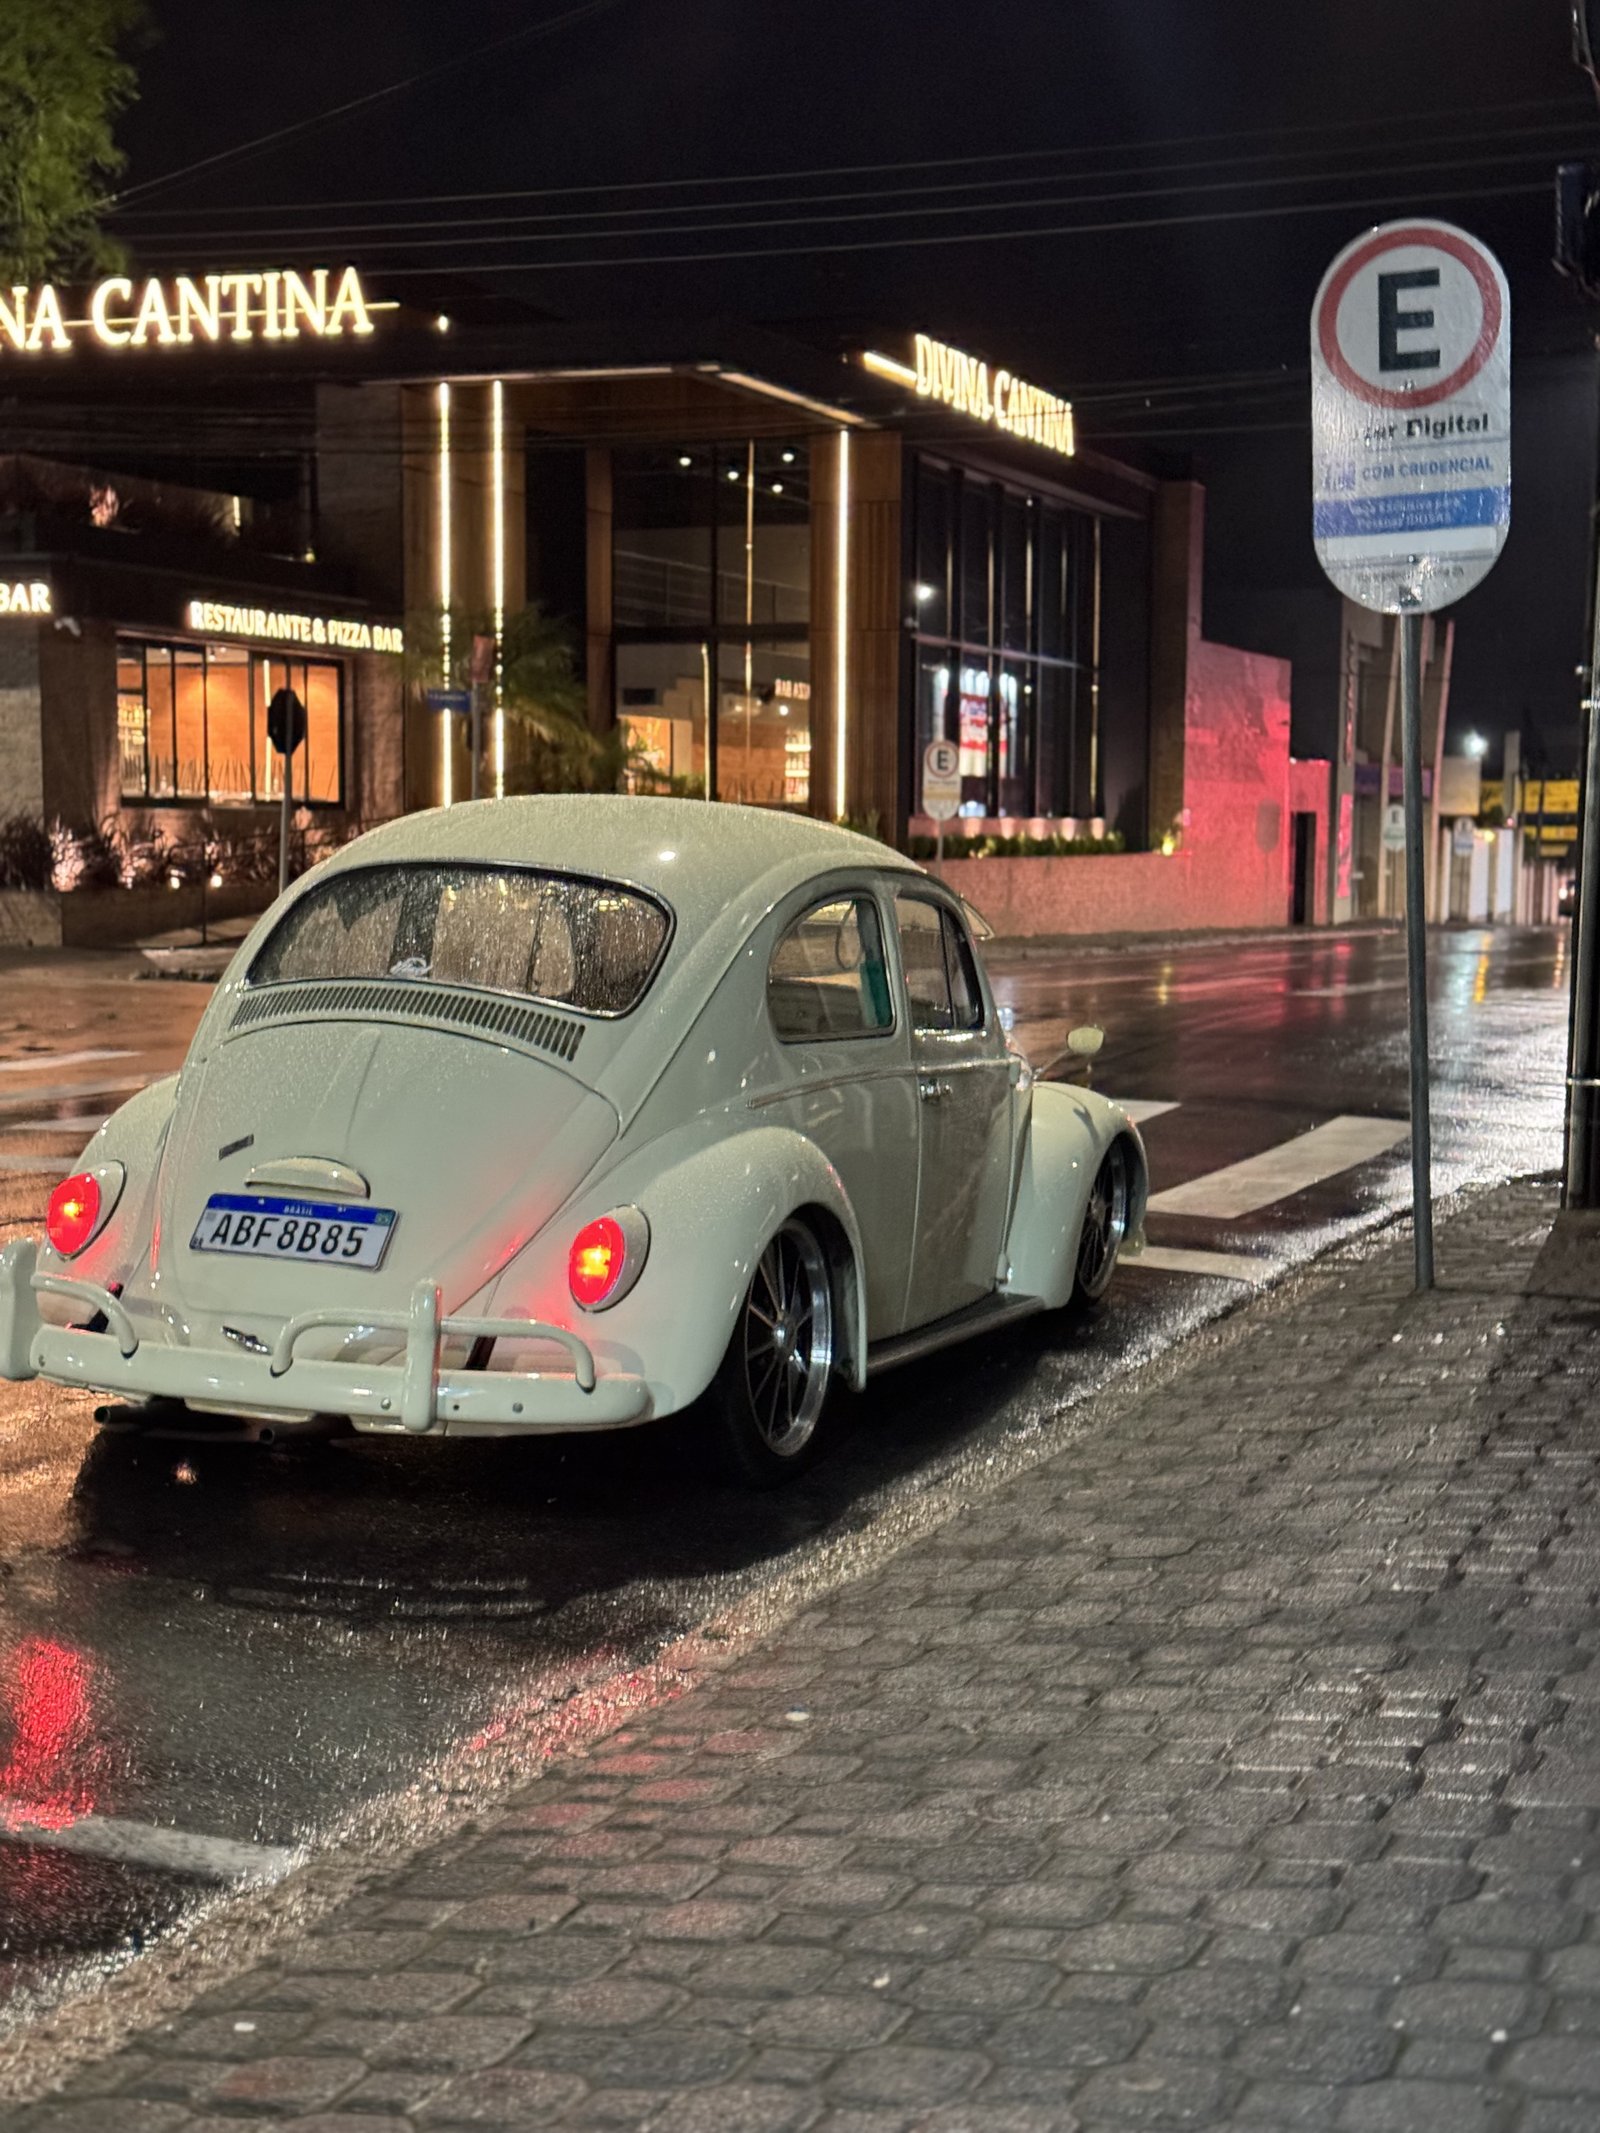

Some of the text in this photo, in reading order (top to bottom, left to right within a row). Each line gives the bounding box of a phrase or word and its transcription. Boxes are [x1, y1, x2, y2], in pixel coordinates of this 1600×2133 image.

[92, 267, 374, 346] CANTINA
[1378, 268, 1441, 373] E
[914, 333, 1075, 457] DIVINA CANTINA
[1406, 413, 1489, 439] Digital
[1362, 463, 1395, 481] COM
[1400, 456, 1494, 478] CREDENCIAL
[189, 601, 404, 653] RESTAURANTE & PIZZA BAR
[209, 1213, 369, 1258] ABF8B85
